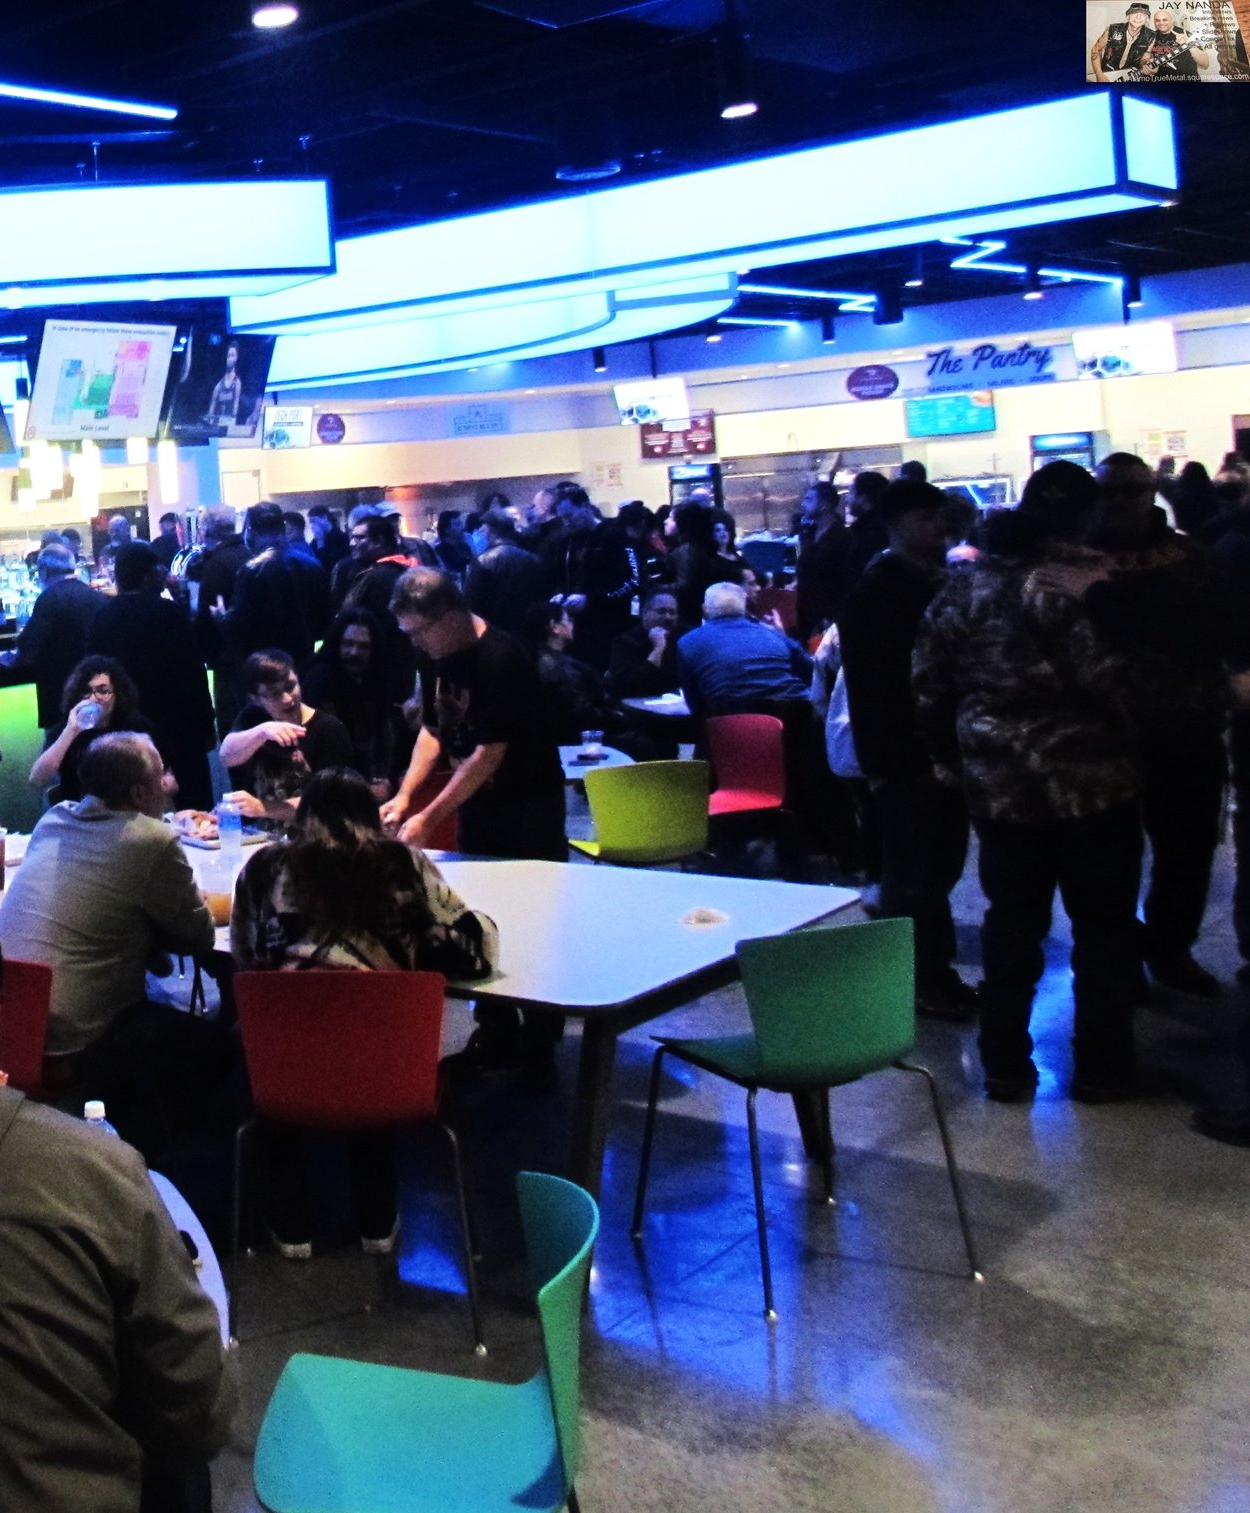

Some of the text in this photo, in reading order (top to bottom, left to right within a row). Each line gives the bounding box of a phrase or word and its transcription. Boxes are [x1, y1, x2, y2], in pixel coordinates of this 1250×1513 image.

[927, 342, 1052, 376] The Pantry
[95, 424, 110, 432] Level
